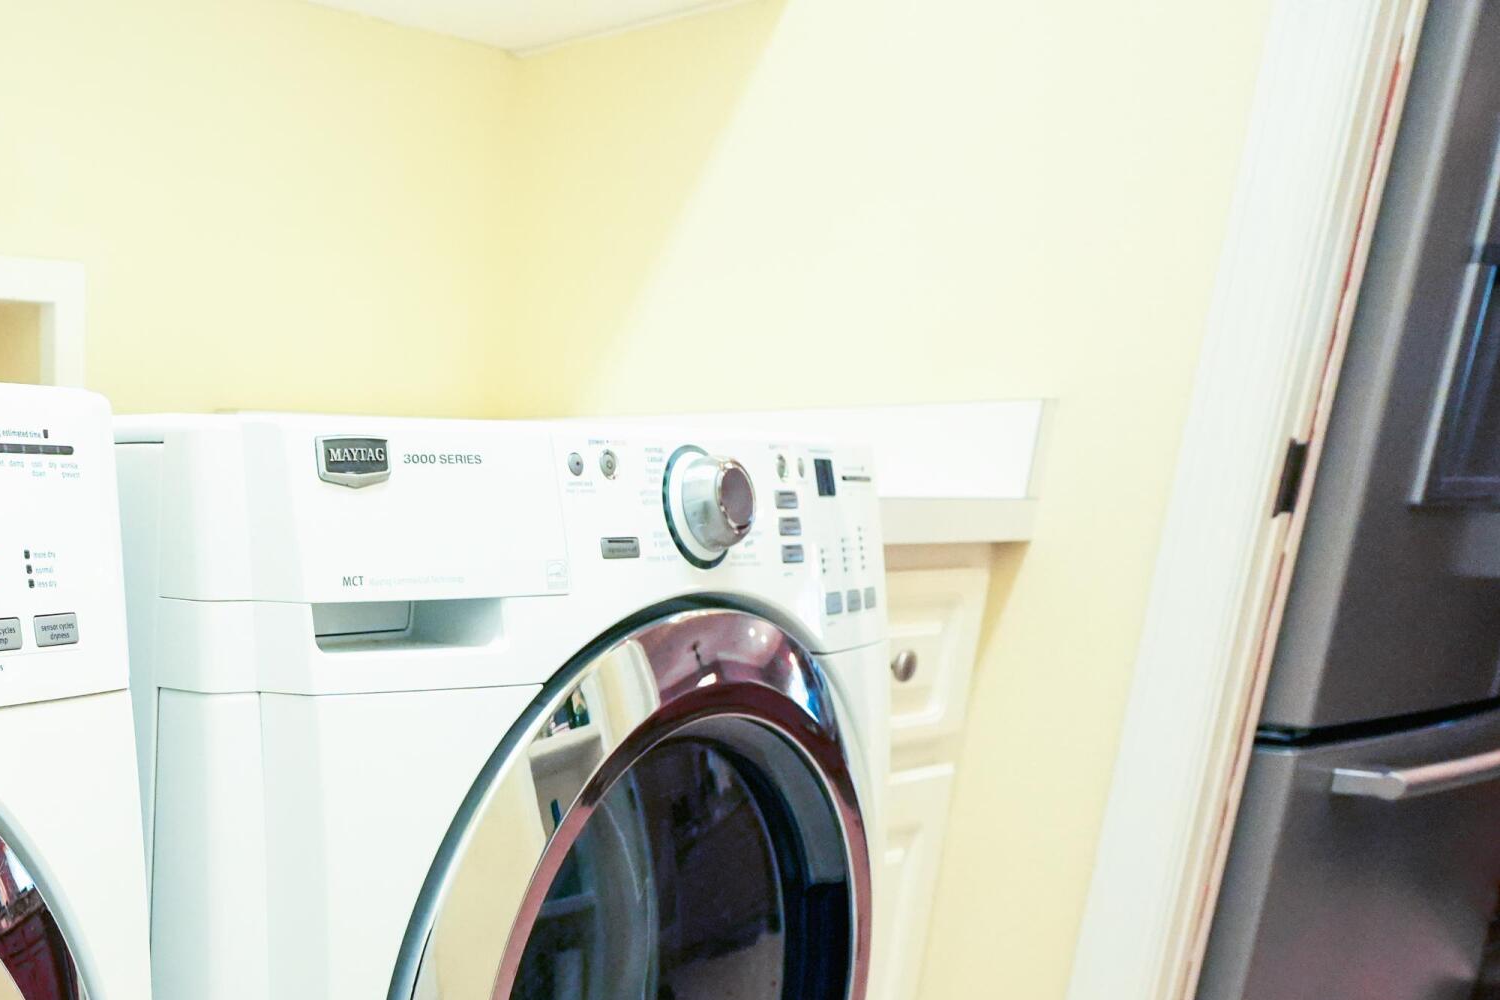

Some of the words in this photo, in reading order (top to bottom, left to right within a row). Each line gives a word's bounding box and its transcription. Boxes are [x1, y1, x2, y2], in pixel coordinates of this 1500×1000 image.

[328, 447, 385, 463] MAYTAG
[404, 453, 438, 465] 3000
[439, 453, 482, 466] SERIES
[342, 575, 364, 588] MCT
[41, 624, 58, 632] sensor
[59, 622, 74, 632] cycles
